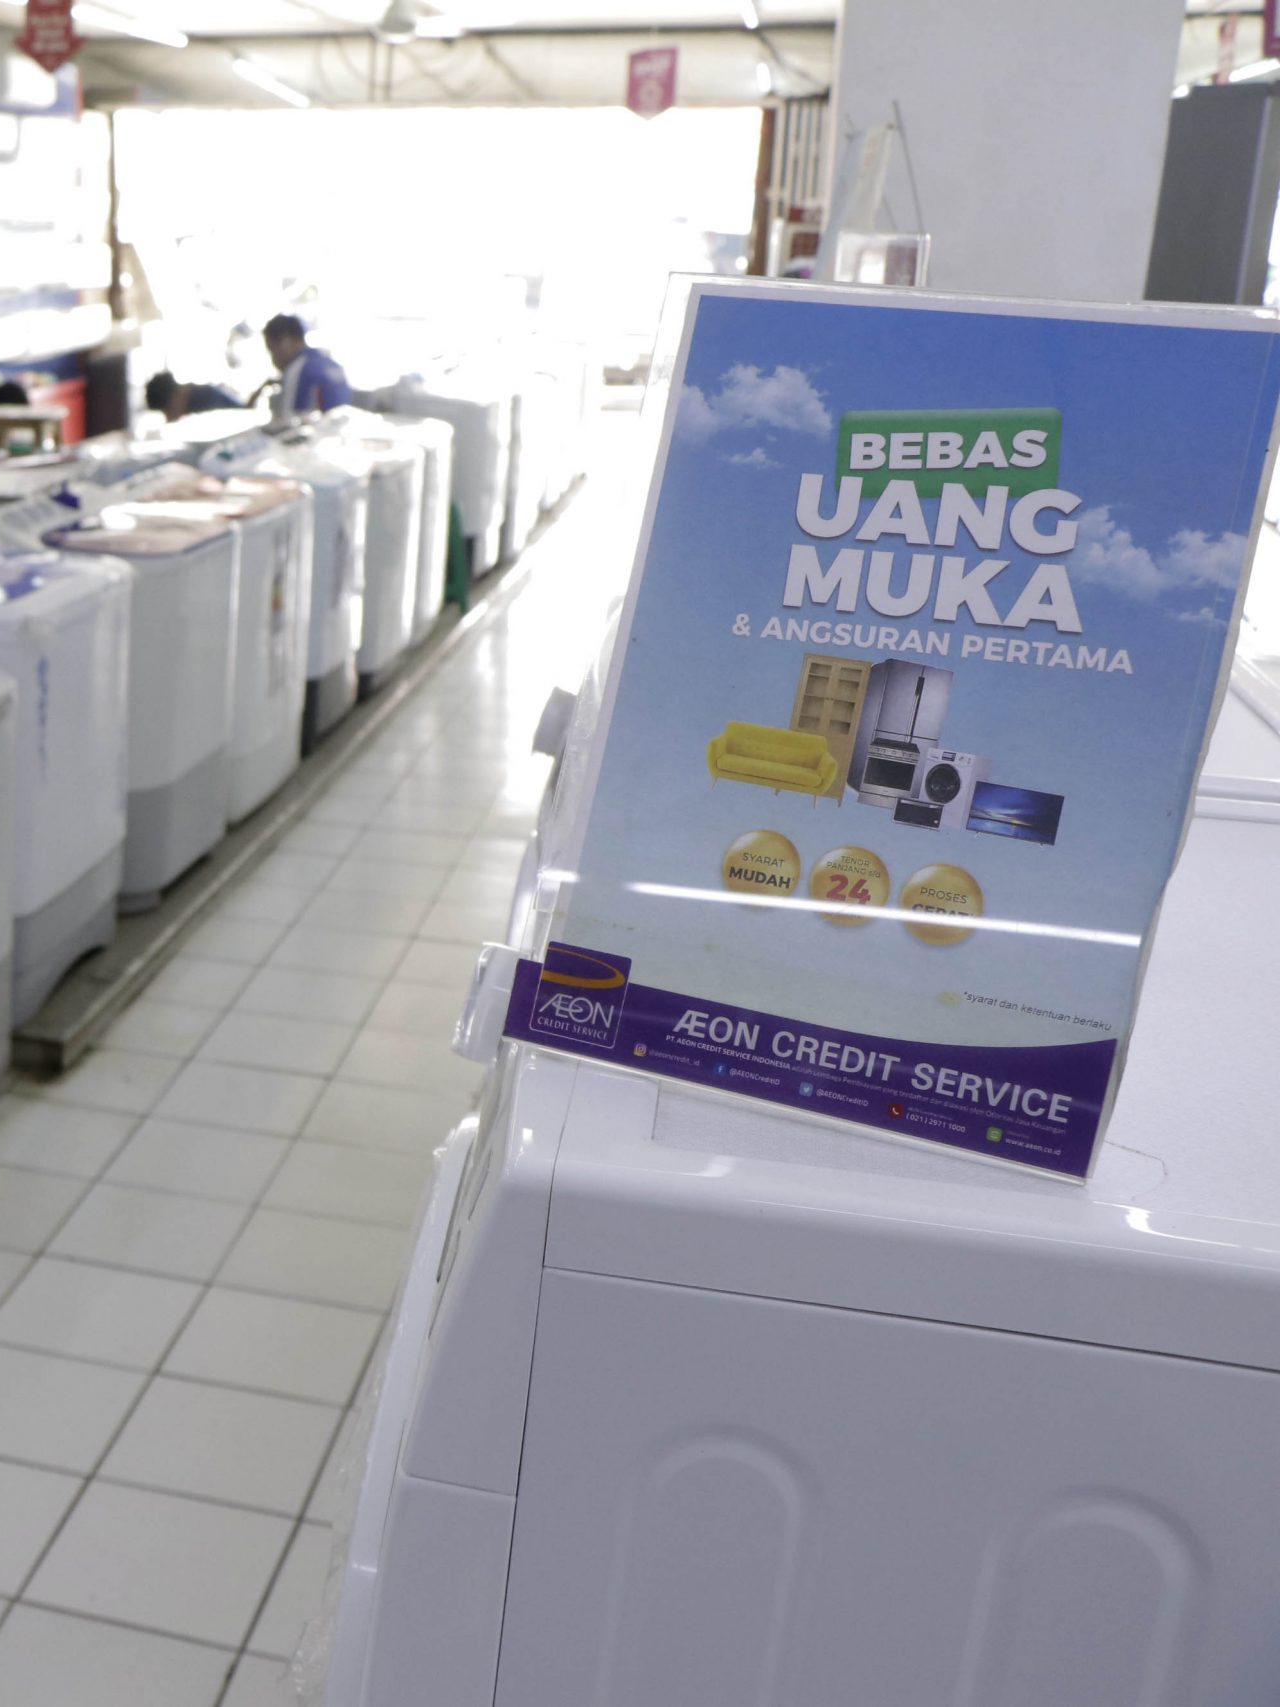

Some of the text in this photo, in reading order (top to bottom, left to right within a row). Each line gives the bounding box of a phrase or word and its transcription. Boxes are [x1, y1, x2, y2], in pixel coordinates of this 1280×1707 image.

[849, 429, 1049, 470] BEBAS
[796, 473, 1083, 555] UANG
[782, 543, 1083, 633] MUKA
[731, 613, 1134, 675] & ANGSURAN PERTAMA
[742, 852, 785, 867] SYARAT
[728, 865, 791, 889] MUDAH
[826, 873, 871, 905] 24
[920, 886, 968, 904] PROSES
[537, 1015, 609, 1041] CREDIT SERVICE
[999, 998, 1018, 1012] dan
[1021, 1003, 1071, 1023] ketentuan
[1072, 1014, 1112, 1032] berlaku
[676, 1037, 697, 1049] AEON
[696, 1042, 722, 1055] CREDIT
[722, 1048, 752, 1062] SERVICE
[752, 1055, 791, 1071] INDONESIA
[771, 1030, 901, 1082] CREDIT
[910, 1062, 1073, 1125] SERVICE
